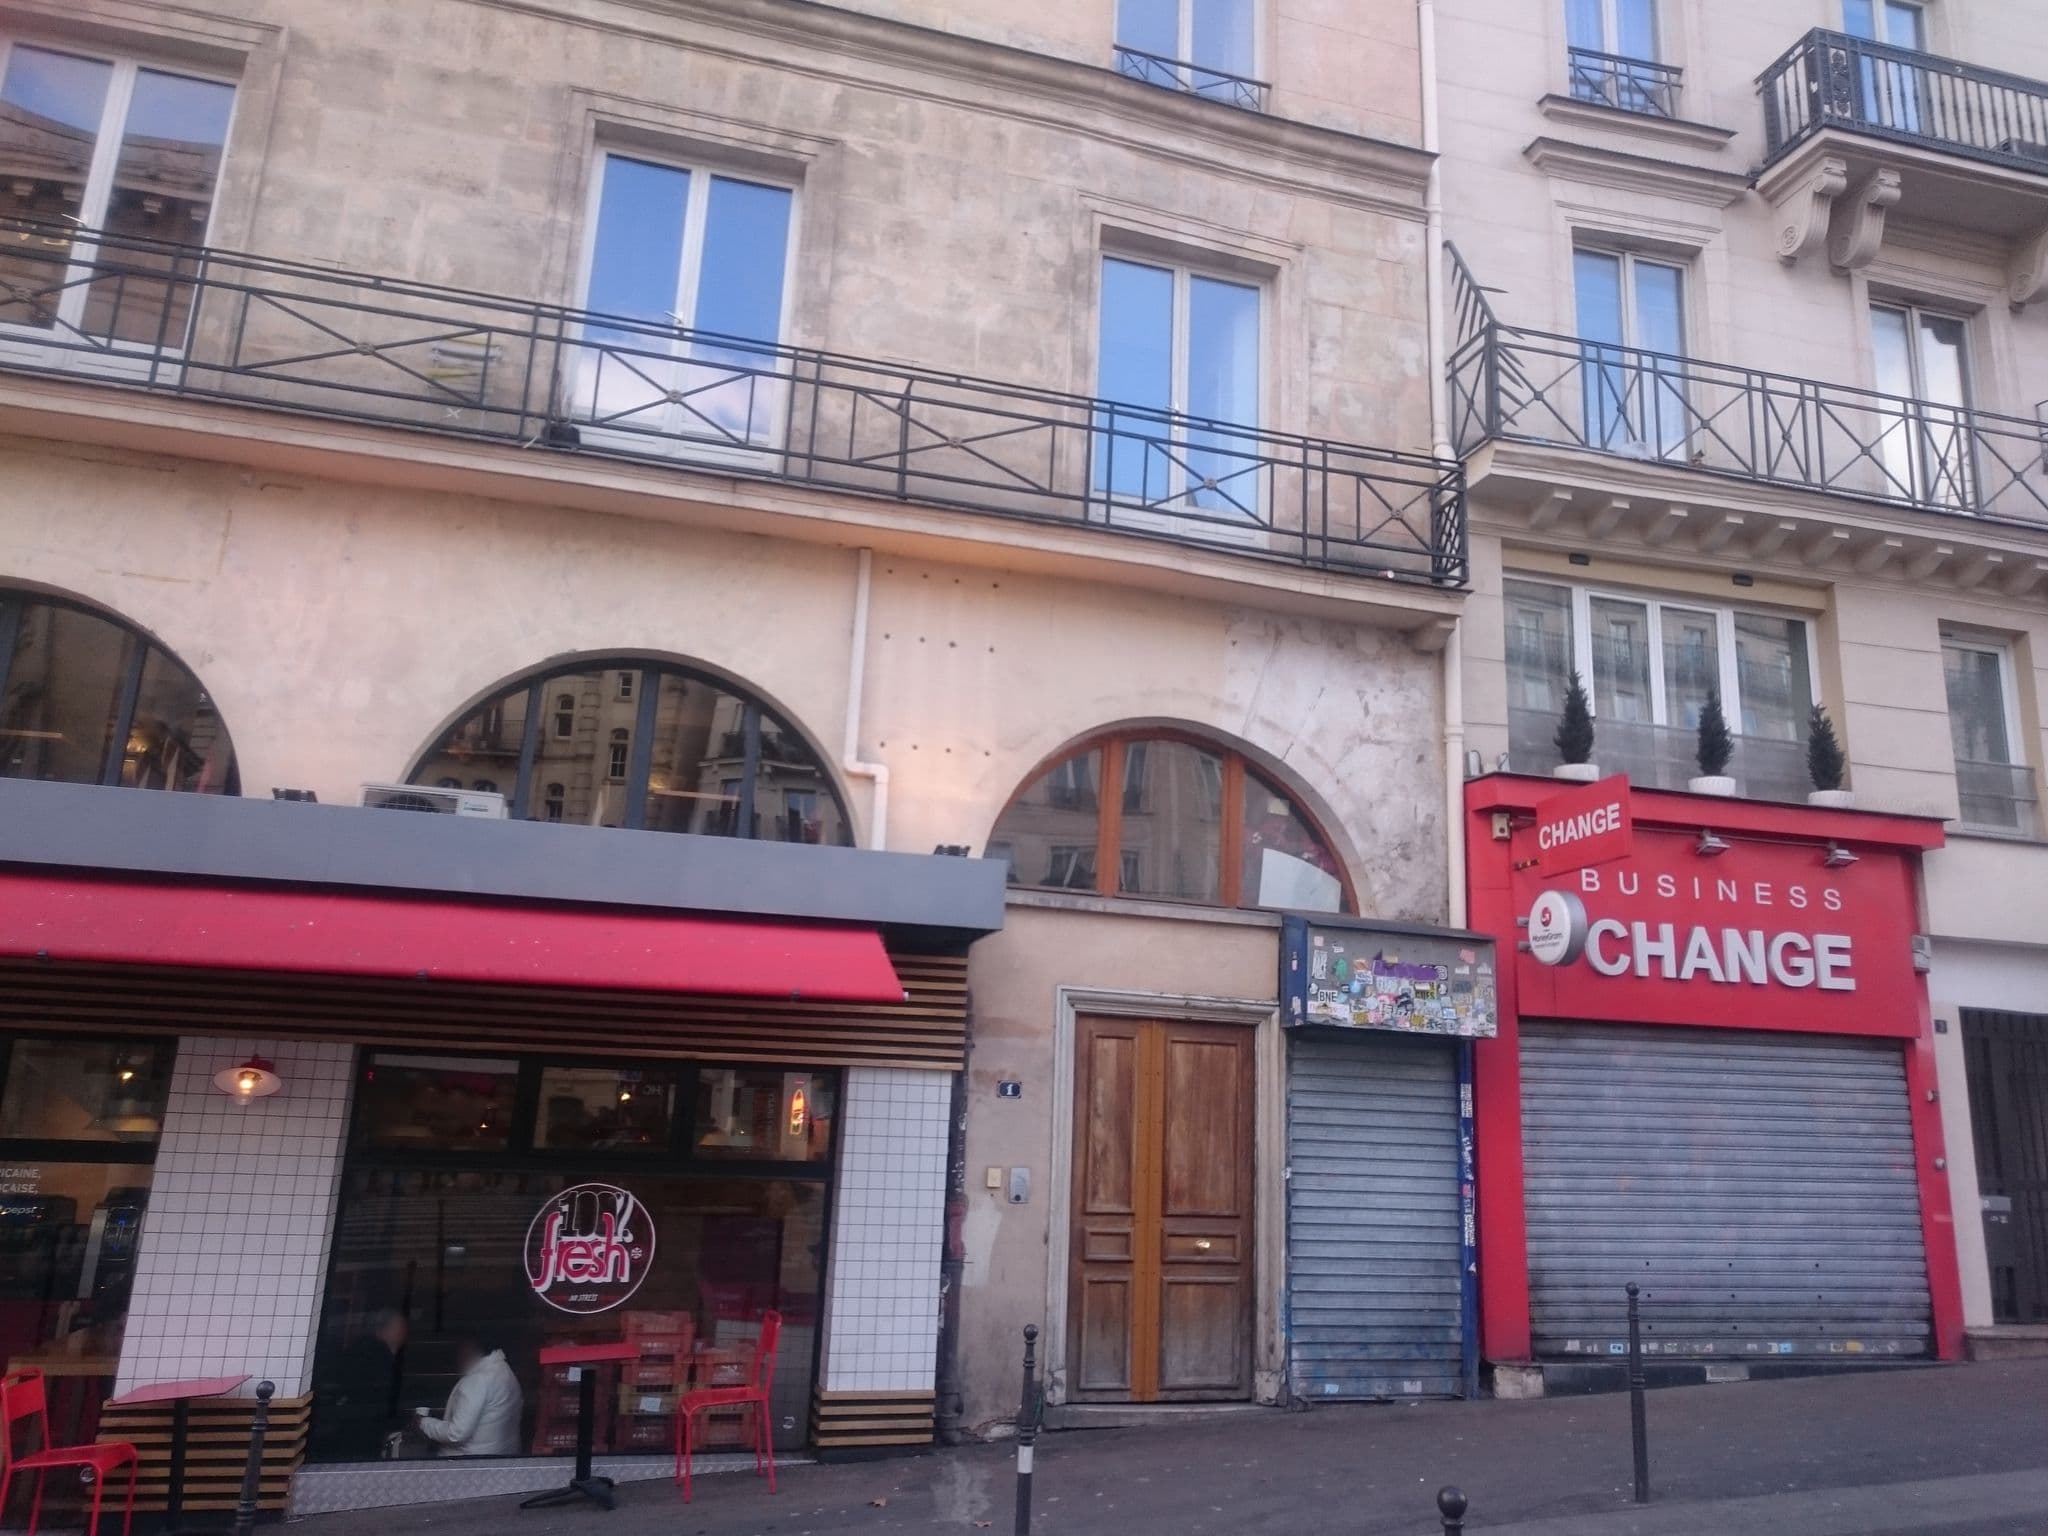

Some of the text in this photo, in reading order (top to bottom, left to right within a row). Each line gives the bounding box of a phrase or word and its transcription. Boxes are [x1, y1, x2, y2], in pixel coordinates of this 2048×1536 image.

[1538, 802, 1622, 850] CHANGE
[1581, 867, 1843, 911] BUSINESS
[1586, 918, 1857, 991] CHANGE
[1319, 991, 1337, 1003] BNE
[1006, 1083, 1014, 1096] 1
[0, 1168, 41, 1179] ICAINE,
[0, 1183, 39, 1195] CAISE,
[558, 1190, 635, 1243] 100%
[531, 1212, 630, 1293] fresh
